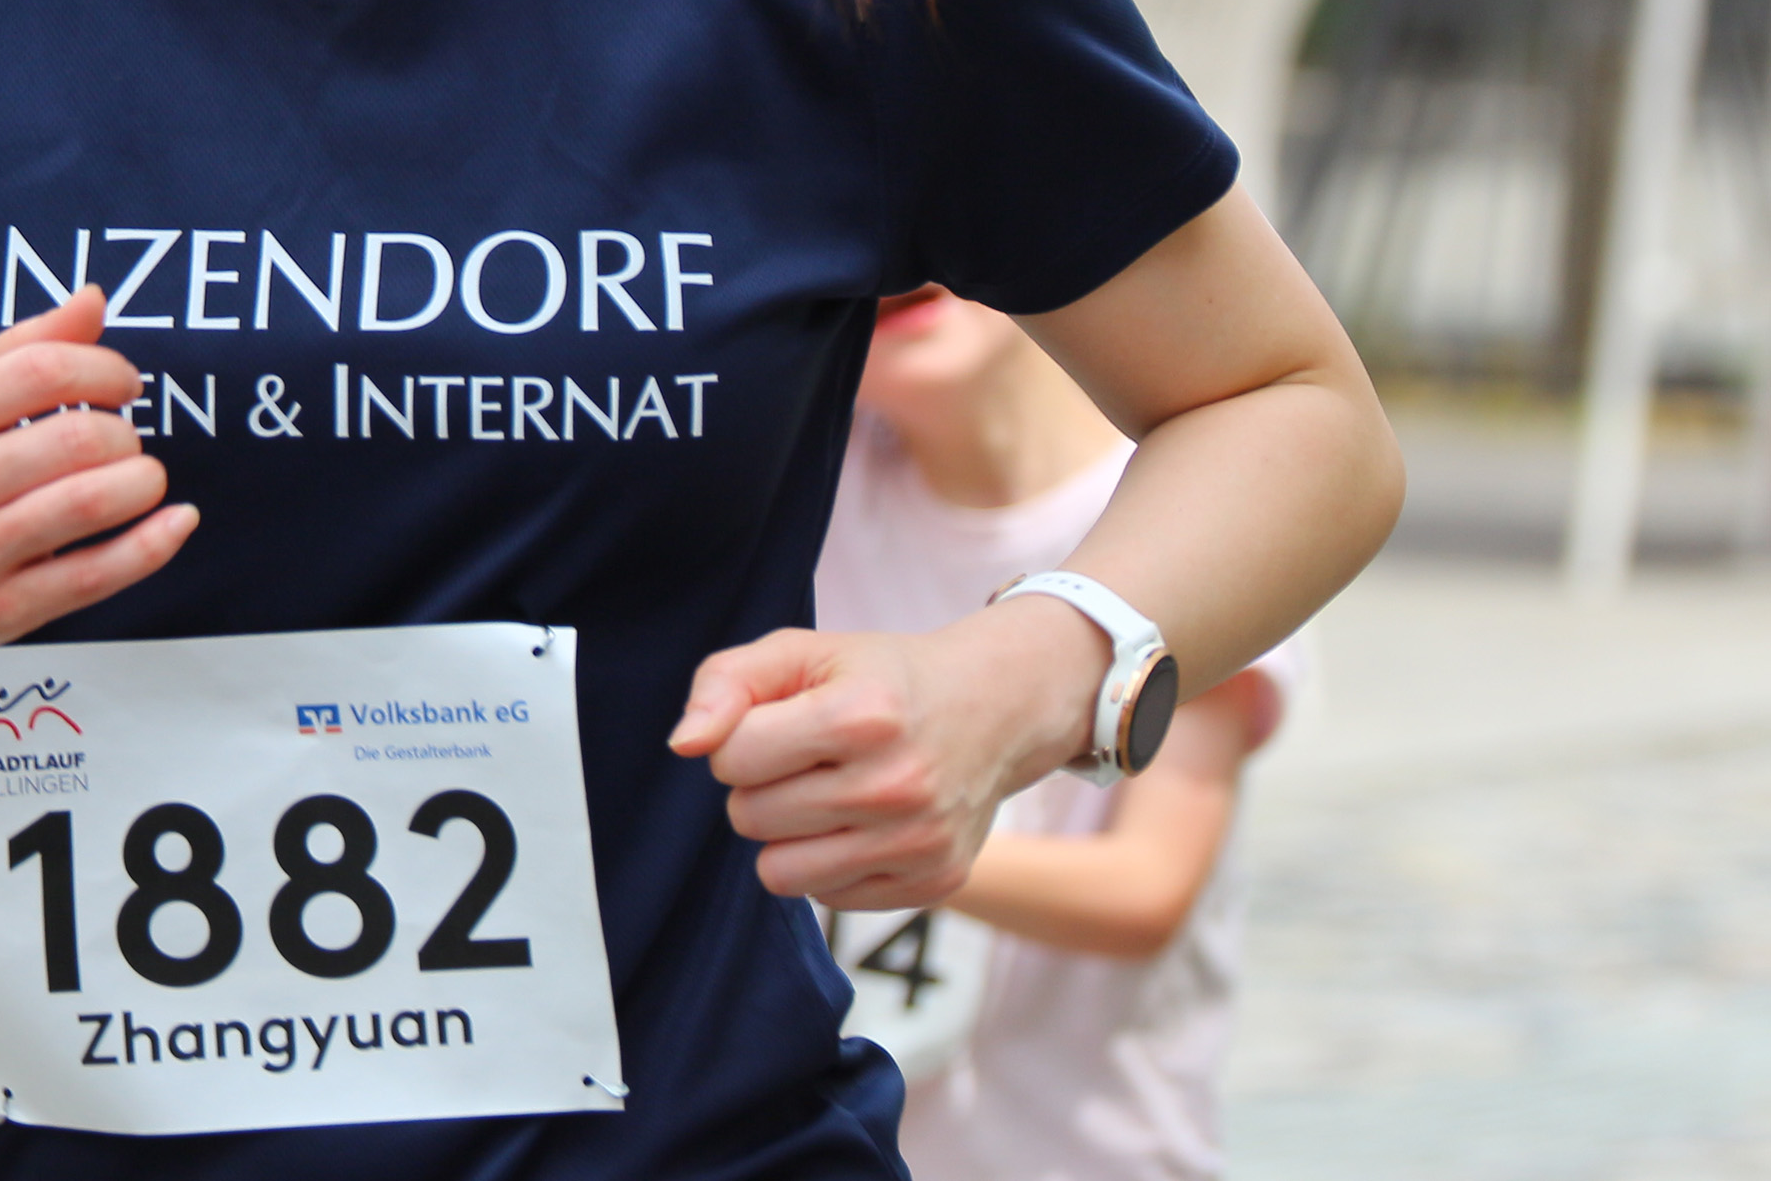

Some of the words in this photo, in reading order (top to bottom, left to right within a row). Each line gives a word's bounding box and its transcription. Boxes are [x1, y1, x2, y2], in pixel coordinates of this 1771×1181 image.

[247, 374, 304, 439] &
[334, 362, 719, 442] INTERNAT
[348, 700, 489, 726] Volksbank
[495, 699, 530, 723] eG
[353, 744, 381, 762] Die
[384, 742, 493, 761] Gestalterbank
[7, 788, 533, 995] 1882
[826, 907, 944, 1010] 4
[76, 1006, 475, 1073] Zhangyuan
